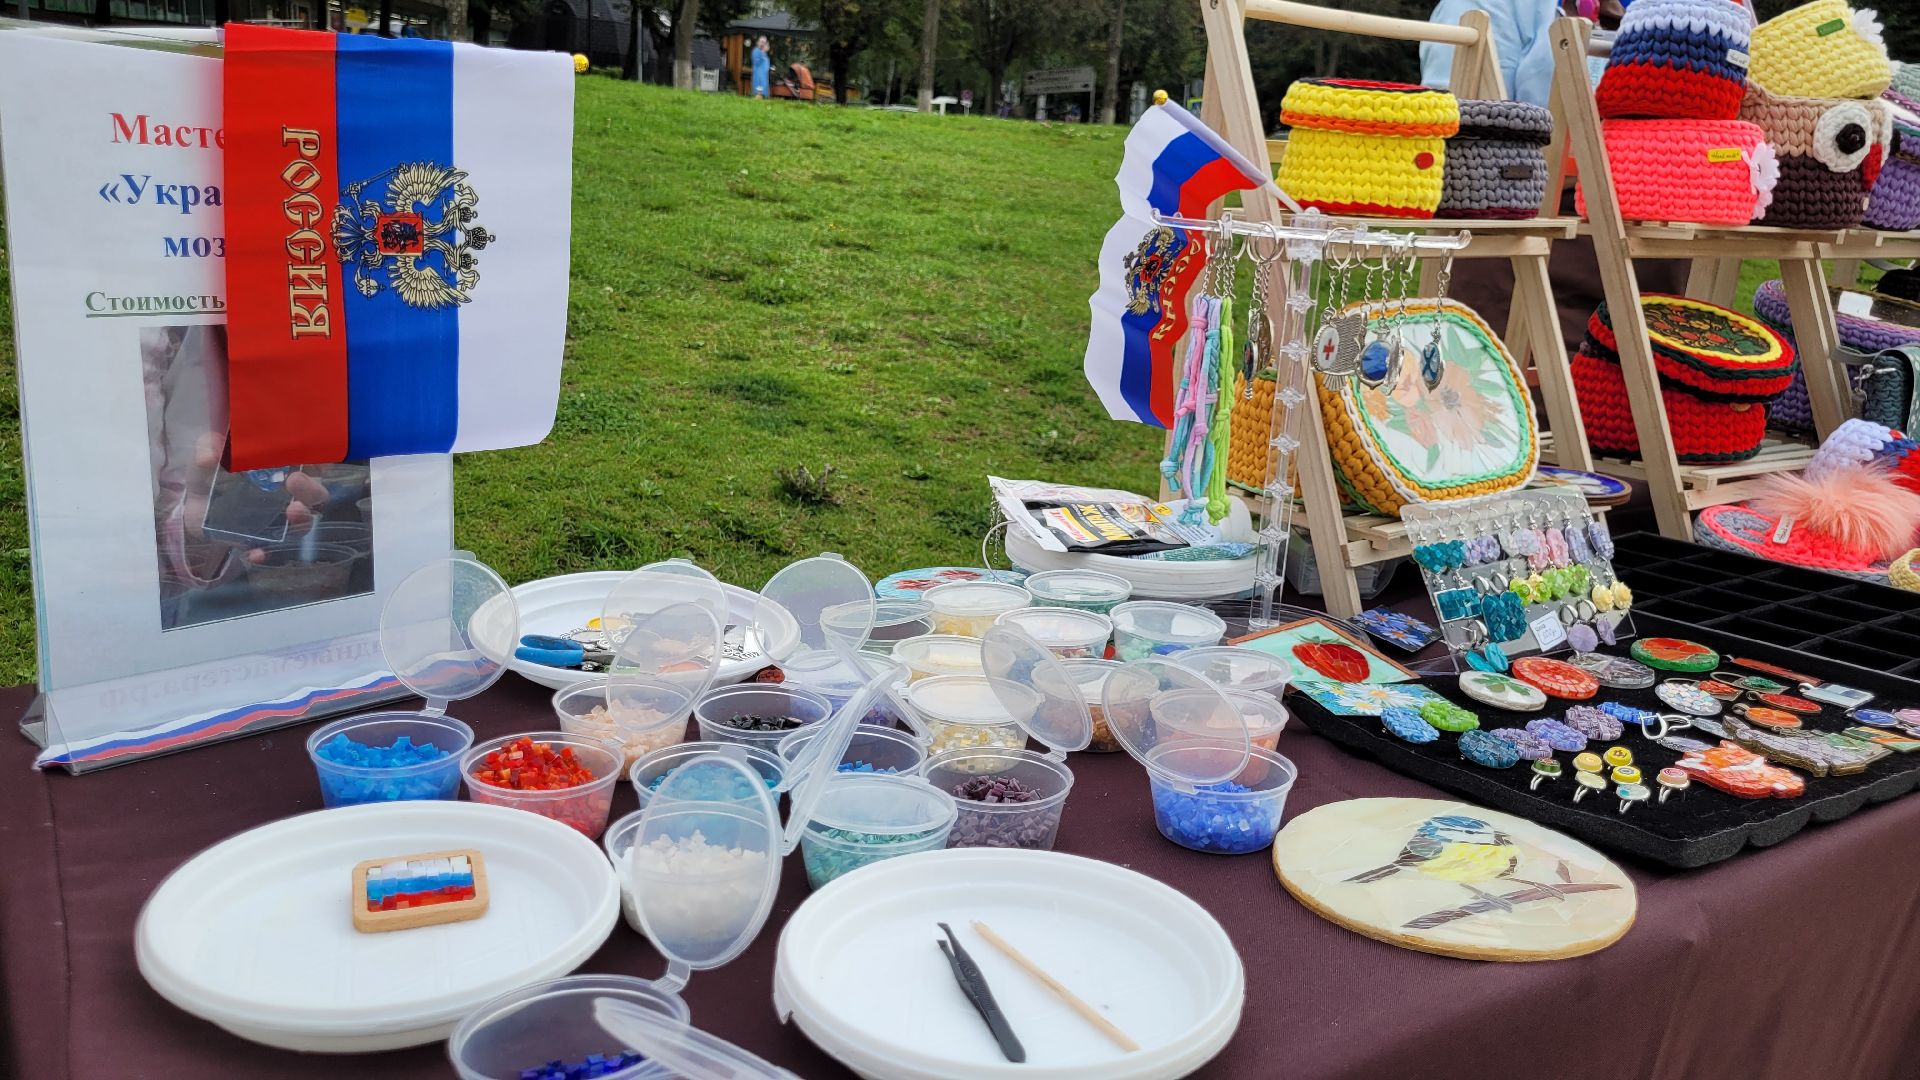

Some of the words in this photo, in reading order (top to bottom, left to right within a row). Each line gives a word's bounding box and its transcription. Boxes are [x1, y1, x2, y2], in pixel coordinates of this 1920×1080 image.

[98, 174, 223, 214] «Укра
[281, 124, 331, 340] РОССИЯ
[163, 237, 225, 258] моз
[85, 291, 225, 312] Стоимость
